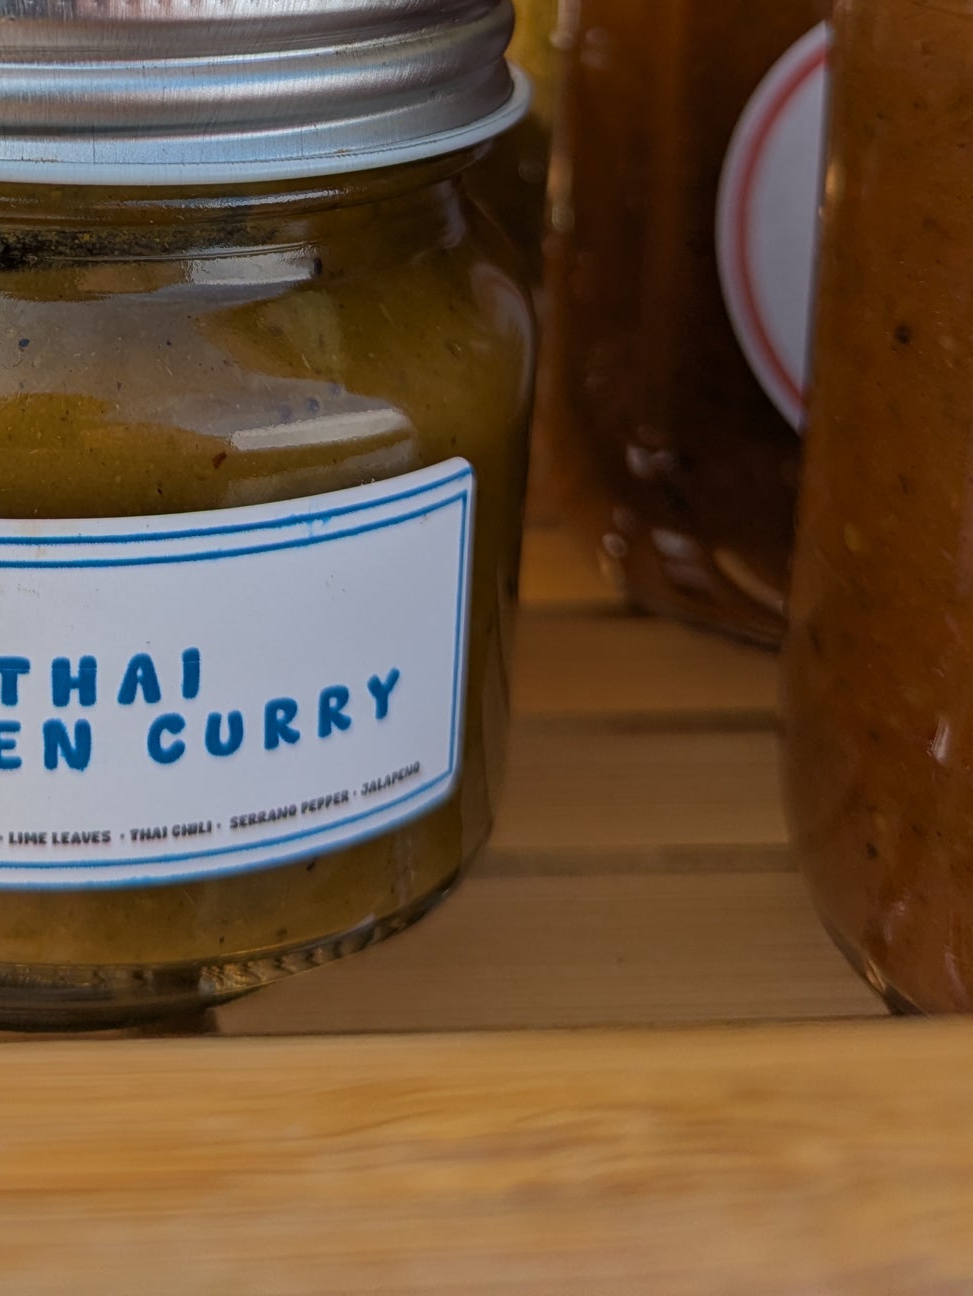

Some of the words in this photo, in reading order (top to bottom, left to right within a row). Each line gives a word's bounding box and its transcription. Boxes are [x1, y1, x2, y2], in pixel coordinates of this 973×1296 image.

[147, 667, 400, 764] CURRY
[8, 830, 47, 844] LIME
[52, 830, 111, 844] LEAVES
[130, 825, 168, 841] THAI
[172, 819, 212, 838] CHILI
[230, 804, 297, 829] SERRANO
[300, 790, 350, 814] PEPPER
